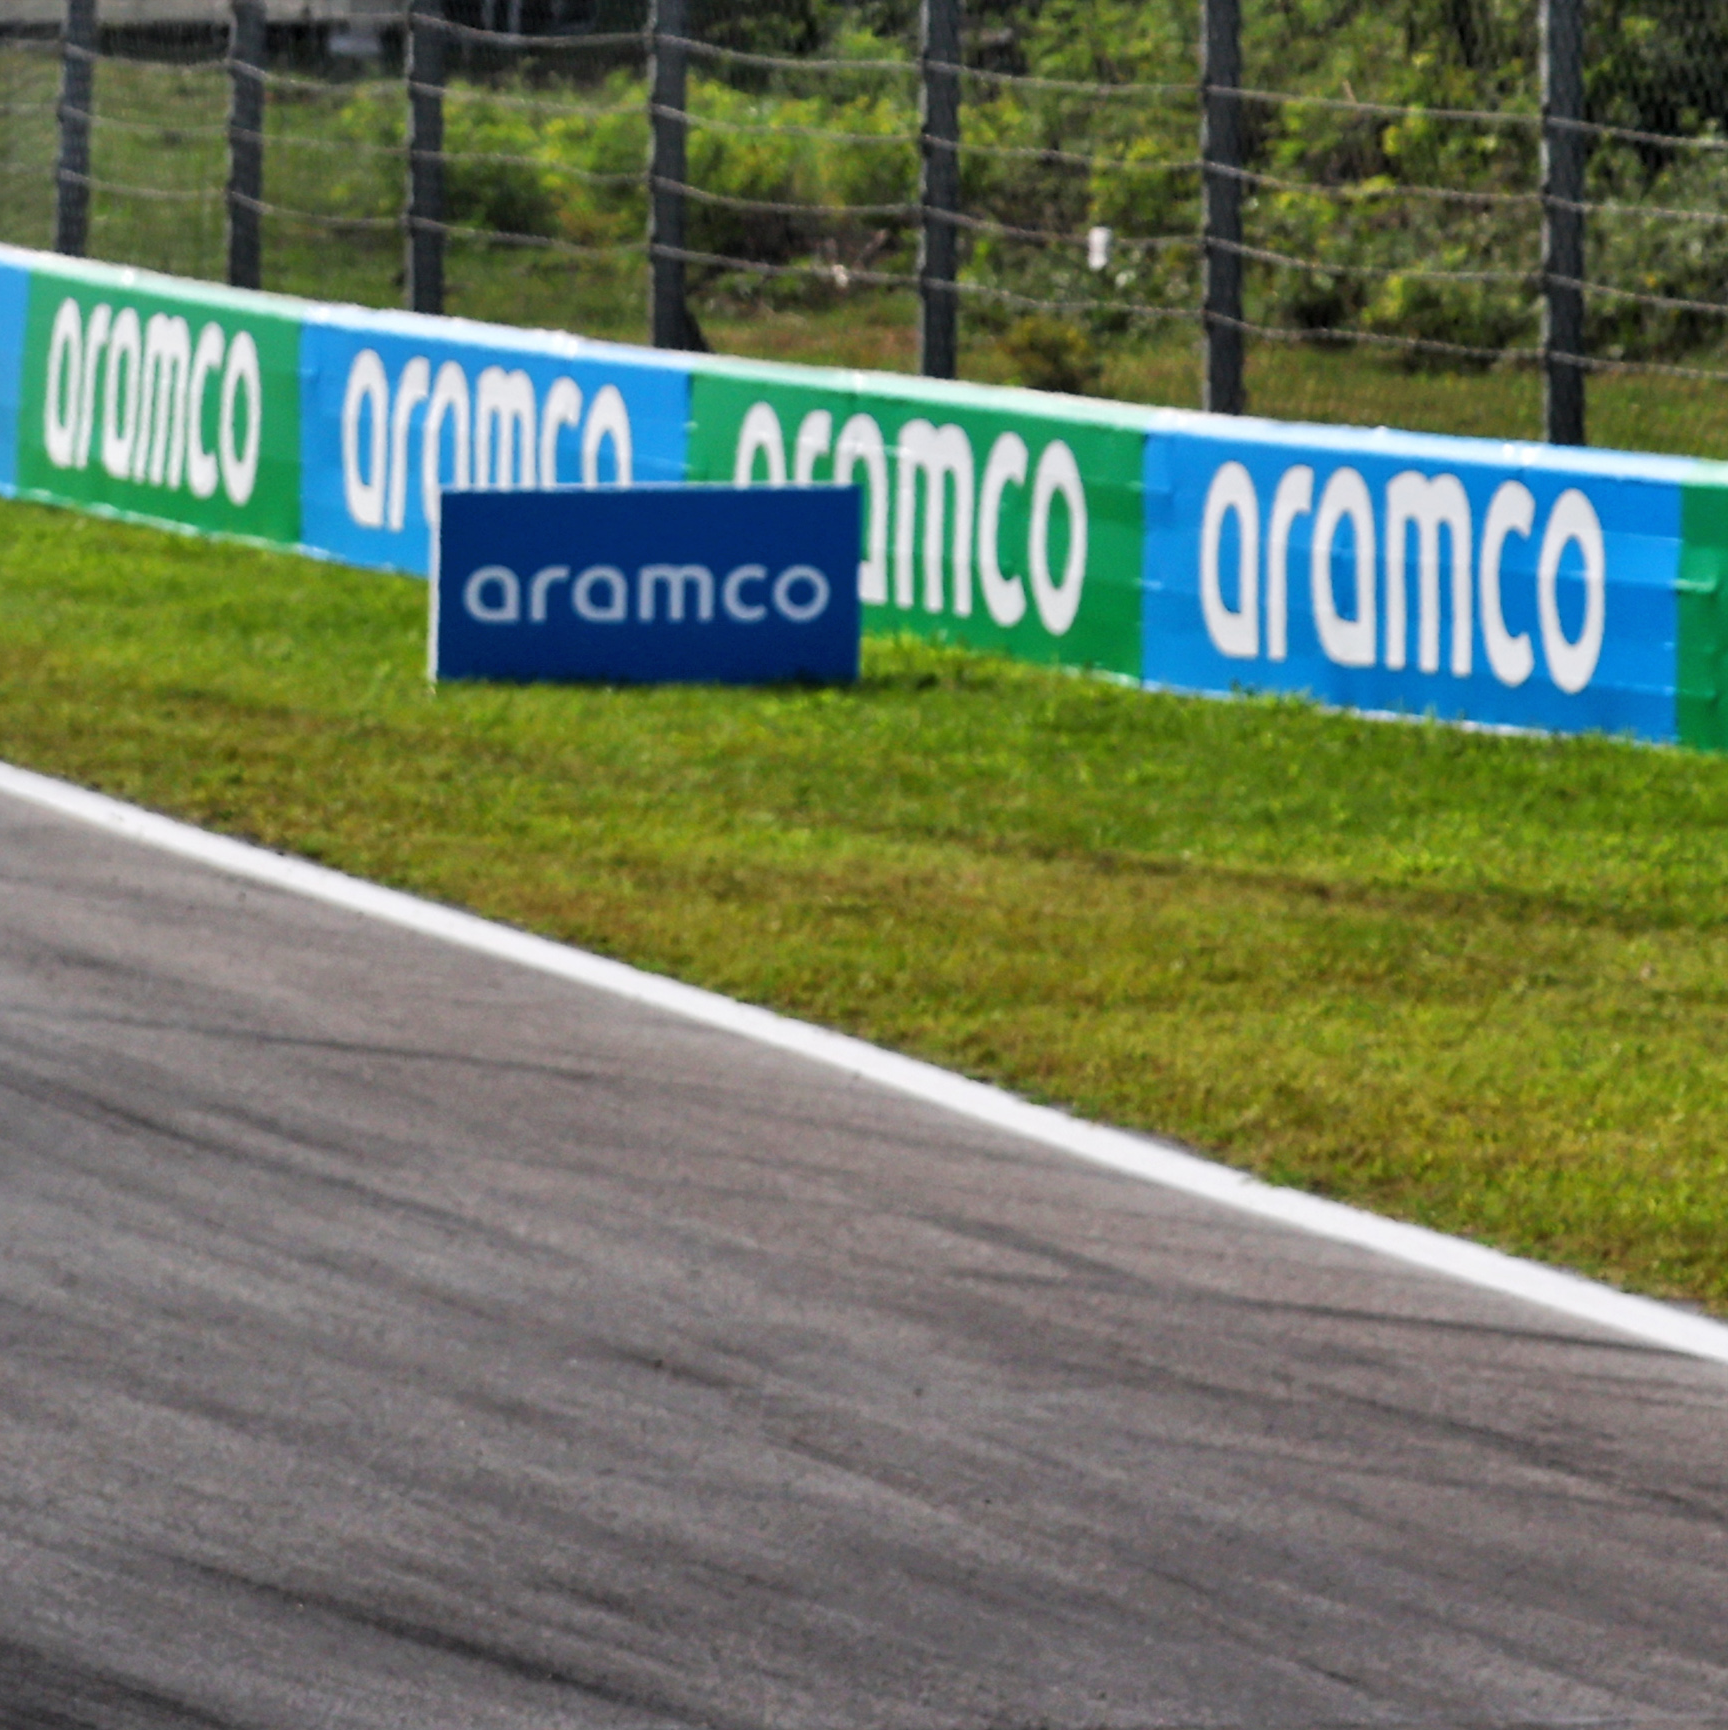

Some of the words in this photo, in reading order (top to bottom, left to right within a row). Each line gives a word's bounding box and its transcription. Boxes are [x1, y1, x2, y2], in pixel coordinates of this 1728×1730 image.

[44, 297, 261, 508] aramco
[463, 563, 830, 624] aramco
[1199, 459, 1606, 695] aramco
